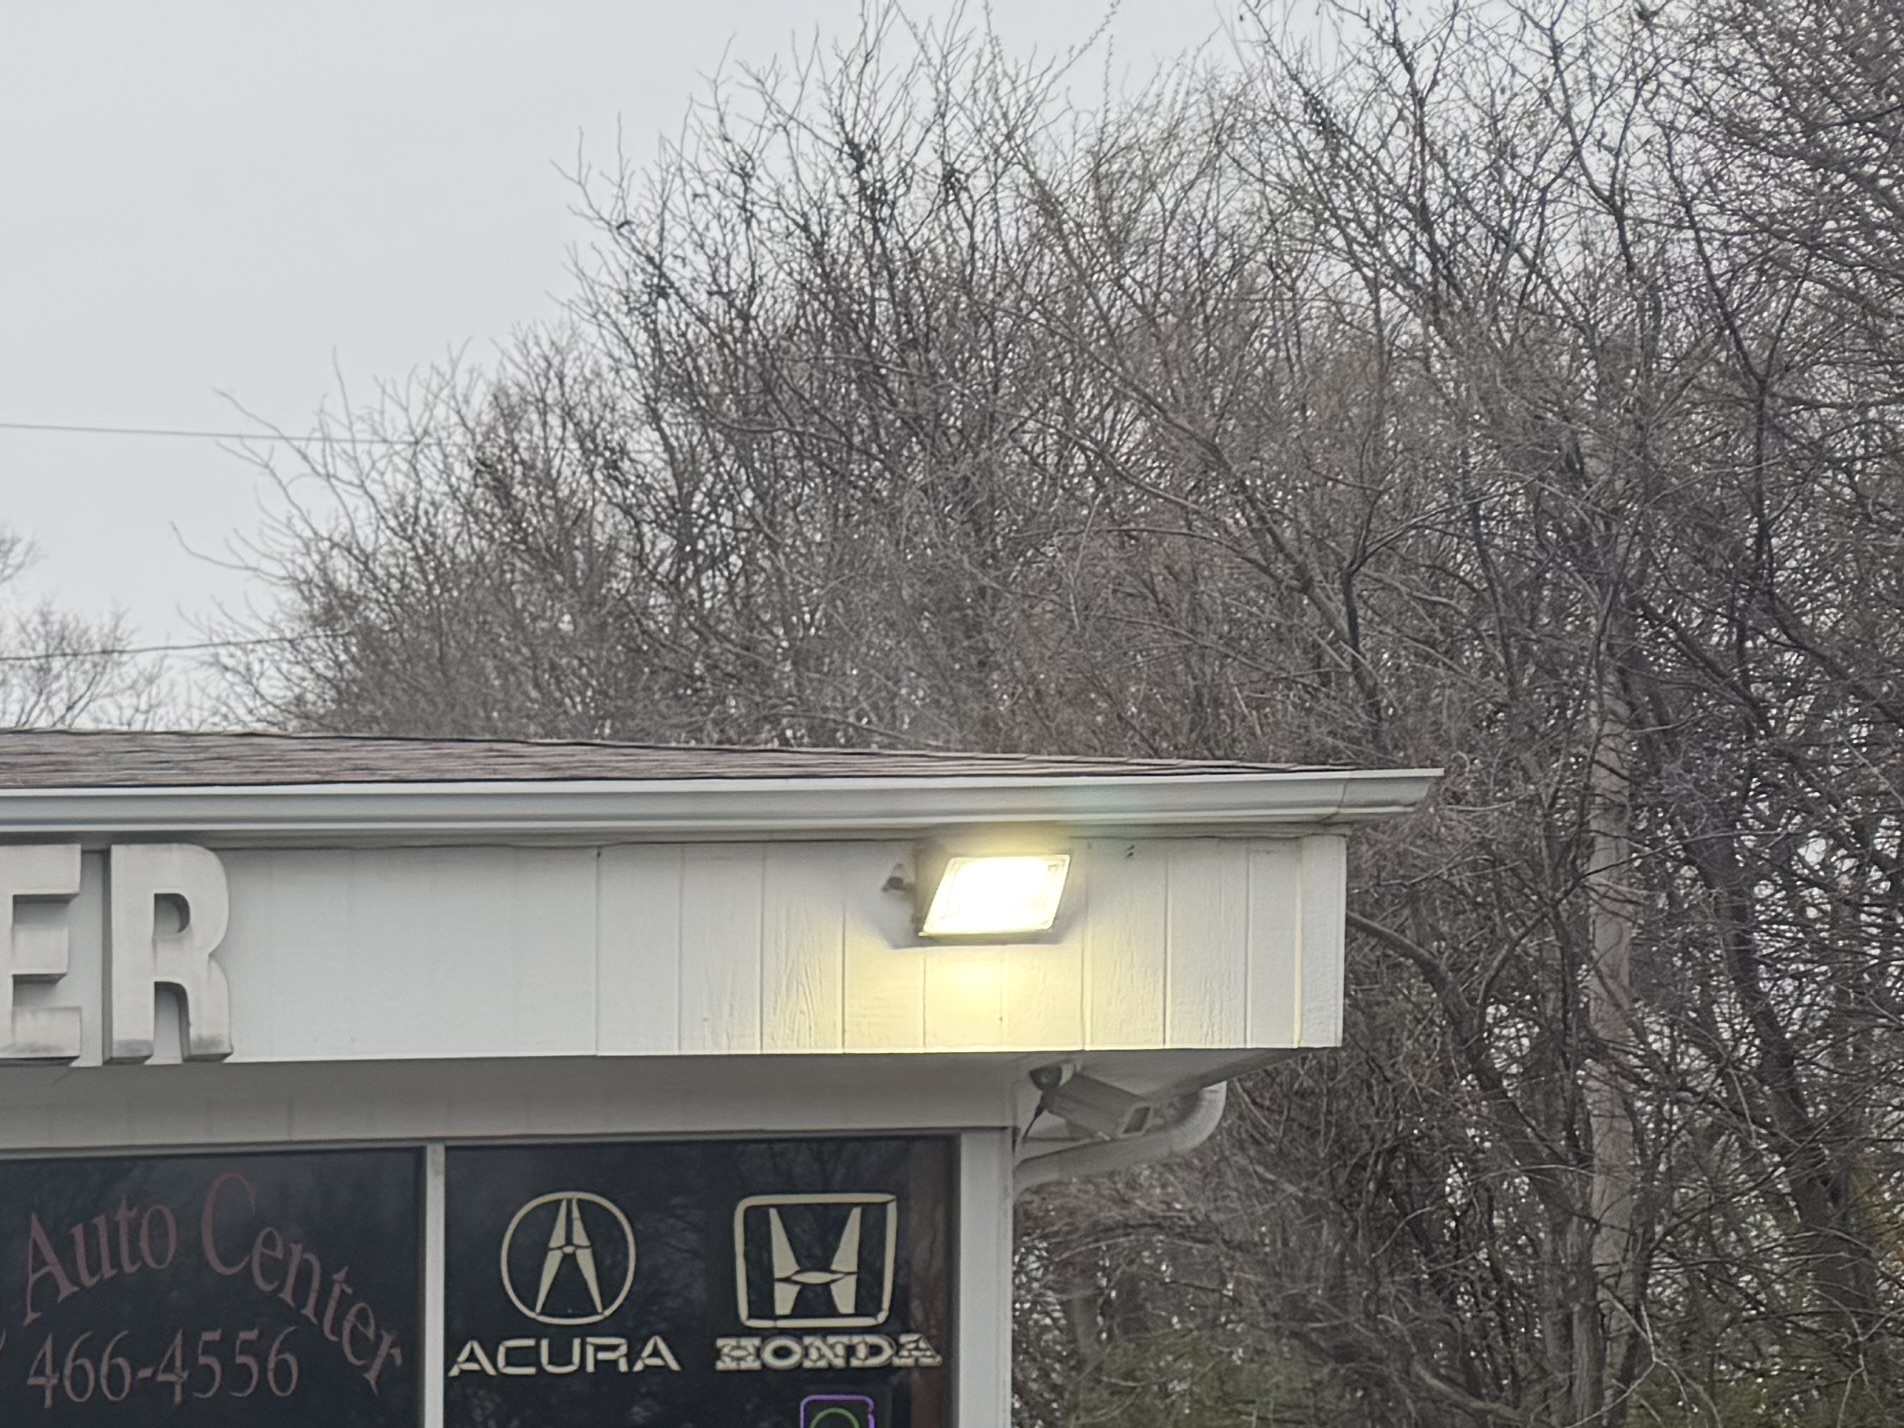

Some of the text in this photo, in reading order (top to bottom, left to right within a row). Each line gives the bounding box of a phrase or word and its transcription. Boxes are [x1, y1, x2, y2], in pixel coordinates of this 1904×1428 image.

[22, 1195, 177, 1327] Auto
[201, 1172, 403, 1396] Center
[26, 1326, 300, 1409] 466-4556
[448, 1335, 682, 1377] ACURA
[715, 1332, 944, 1372] HONDA
